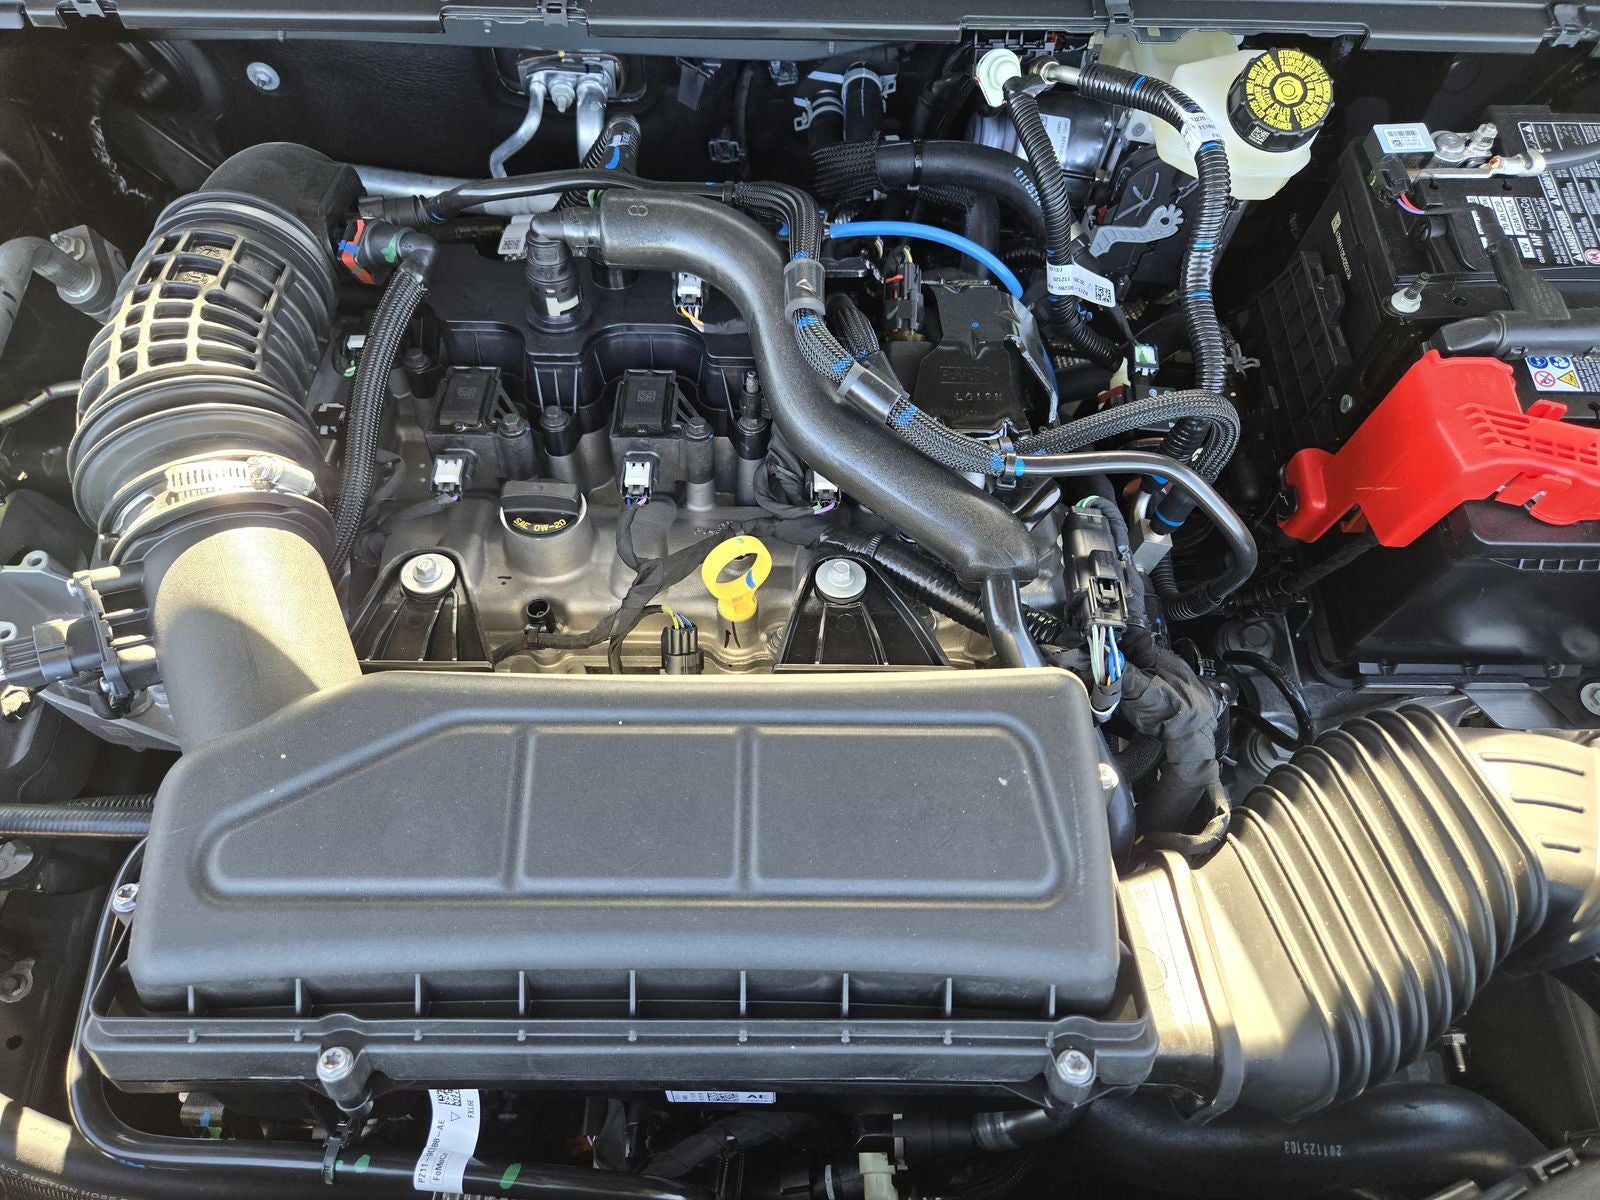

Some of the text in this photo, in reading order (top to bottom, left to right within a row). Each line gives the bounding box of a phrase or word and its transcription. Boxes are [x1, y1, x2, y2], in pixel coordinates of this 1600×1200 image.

[1519, 199, 1538, 229] FoMoCo
[1530, 232, 1544, 246] MF
[513, 517, 567, 532] SAE 0W-20
[433, 1152, 448, 1181] FoMoCo
[22, 1173, 78, 1193] SUCTION
[81, 1190, 117, 1200] HOSE
